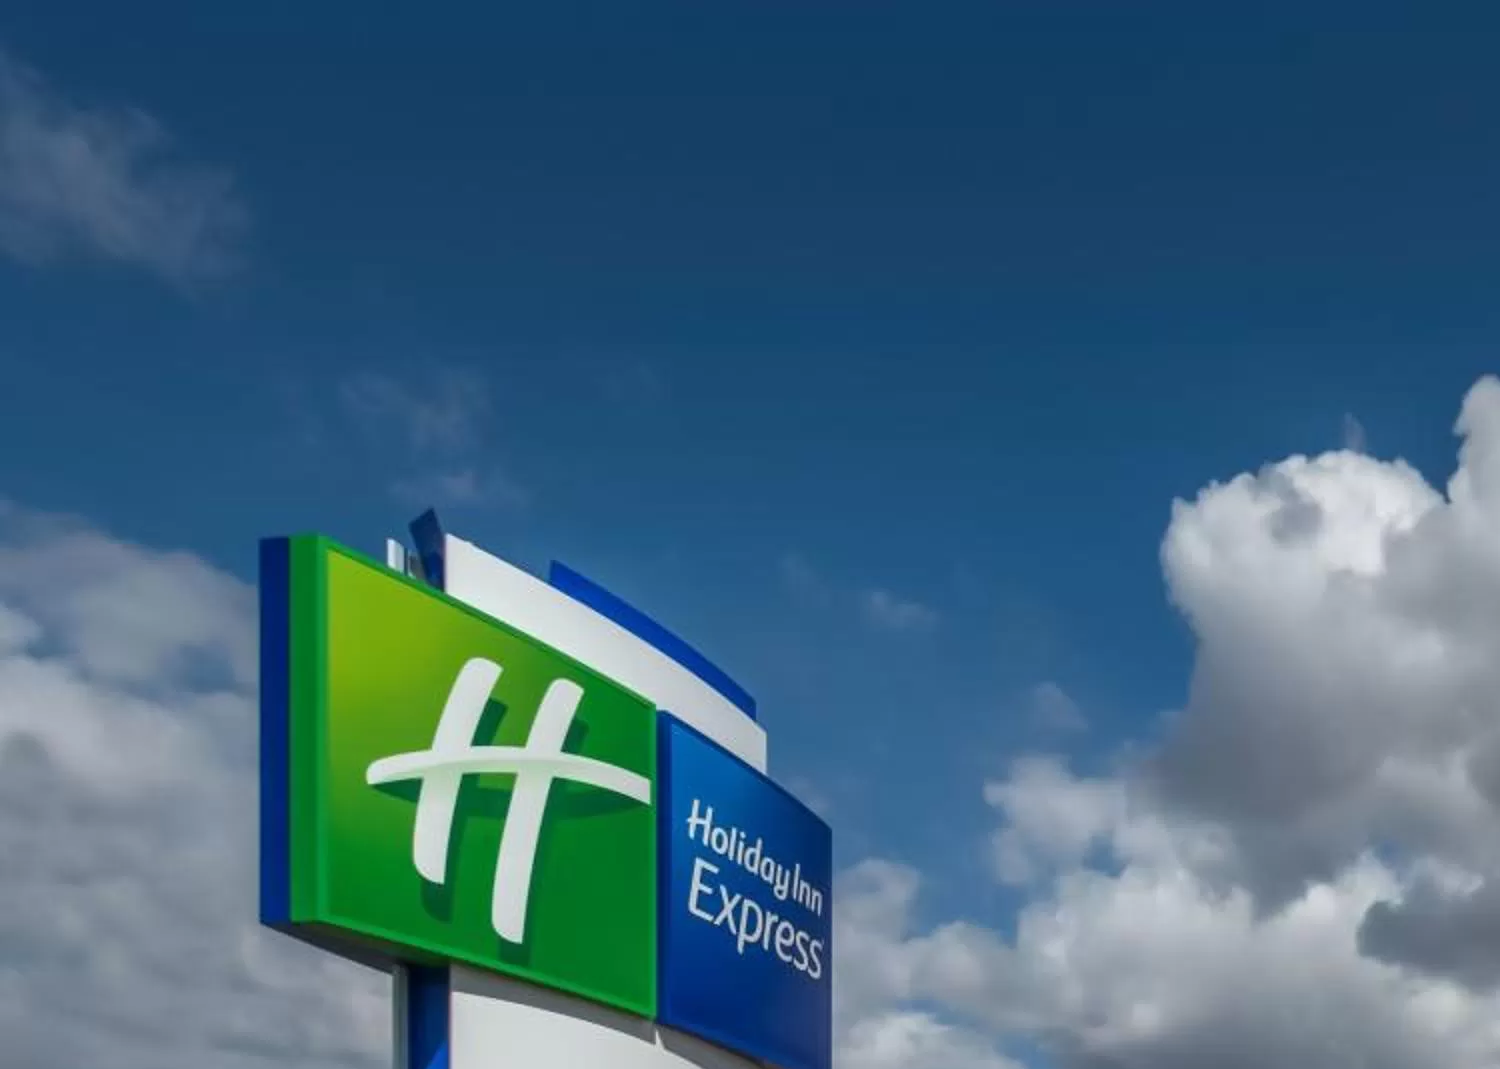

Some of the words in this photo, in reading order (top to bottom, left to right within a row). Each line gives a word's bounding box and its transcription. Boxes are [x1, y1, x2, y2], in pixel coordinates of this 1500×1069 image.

[686, 799, 790, 900] Holiday
[792, 863, 823, 917] Inn
[688, 857, 823, 979] Express
